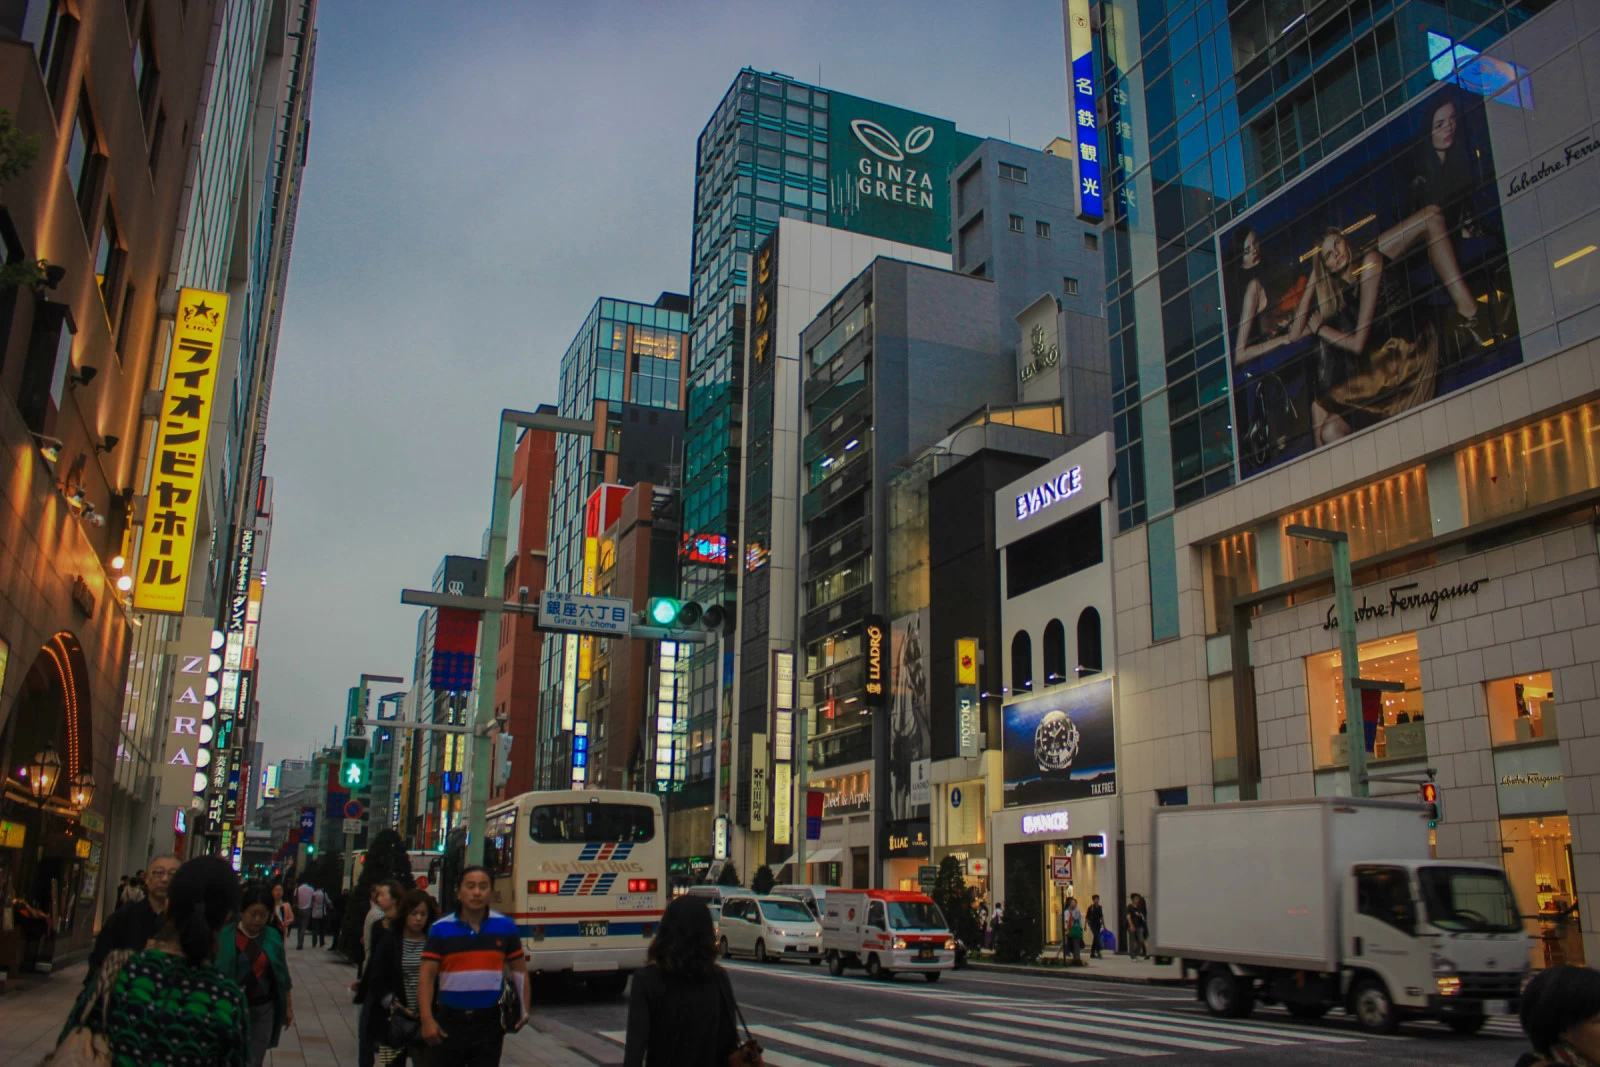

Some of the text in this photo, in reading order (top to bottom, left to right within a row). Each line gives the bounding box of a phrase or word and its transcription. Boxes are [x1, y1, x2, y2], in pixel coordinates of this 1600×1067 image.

[1076, 78, 1100, 197] 名鉄観光
[859, 157, 934, 190] GINZA
[859, 177, 934, 209] GREEN
[1507, 159, 1565, 198] Salvatore
[185, 323, 213, 333] LION
[142, 336, 214, 586] ライオンビヤホール
[1015, 464, 1083, 521] EVANCE
[546, 600, 626, 623] 銀座六丁目
[1389, 577, 1490, 622] Ferragamo
[554, 616, 617, 631] Ginza 6-chome
[868, 626, 882, 680] LLADRÓ
[167, 655, 203, 766] ZARA
[1091, 781, 1114, 795] TAX FREE
